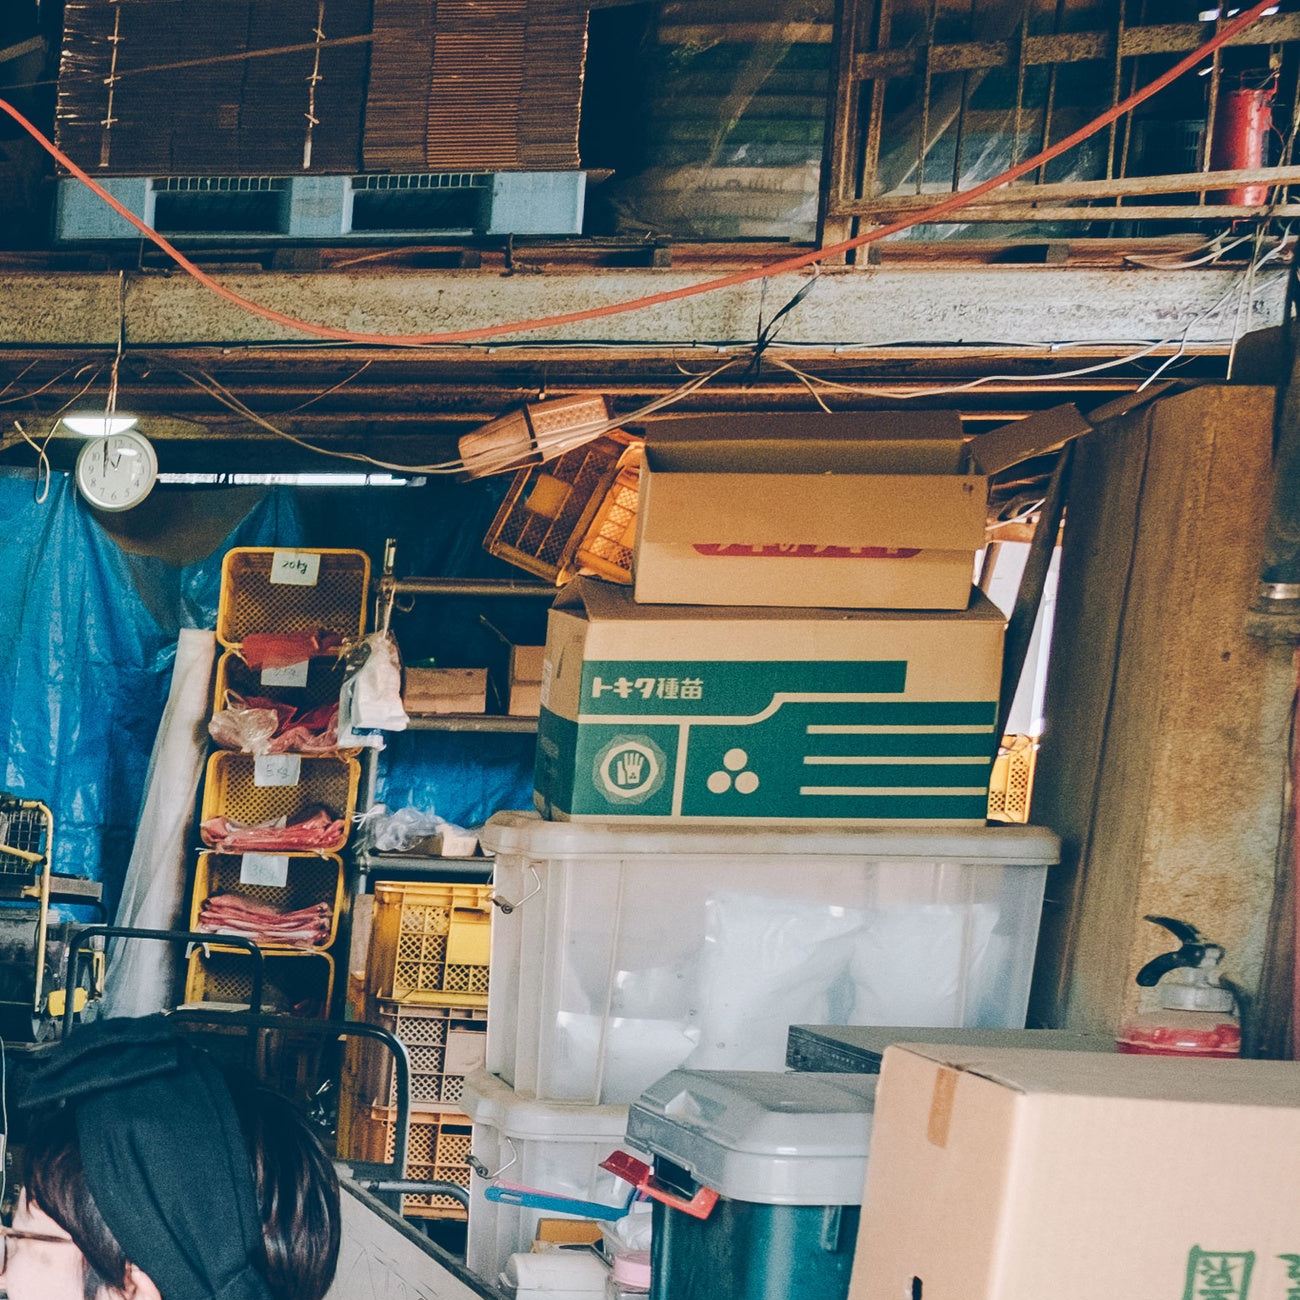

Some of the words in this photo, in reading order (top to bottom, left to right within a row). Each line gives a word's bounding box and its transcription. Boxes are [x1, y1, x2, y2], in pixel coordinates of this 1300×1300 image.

[591, 676, 704, 700] トキタ種苗
